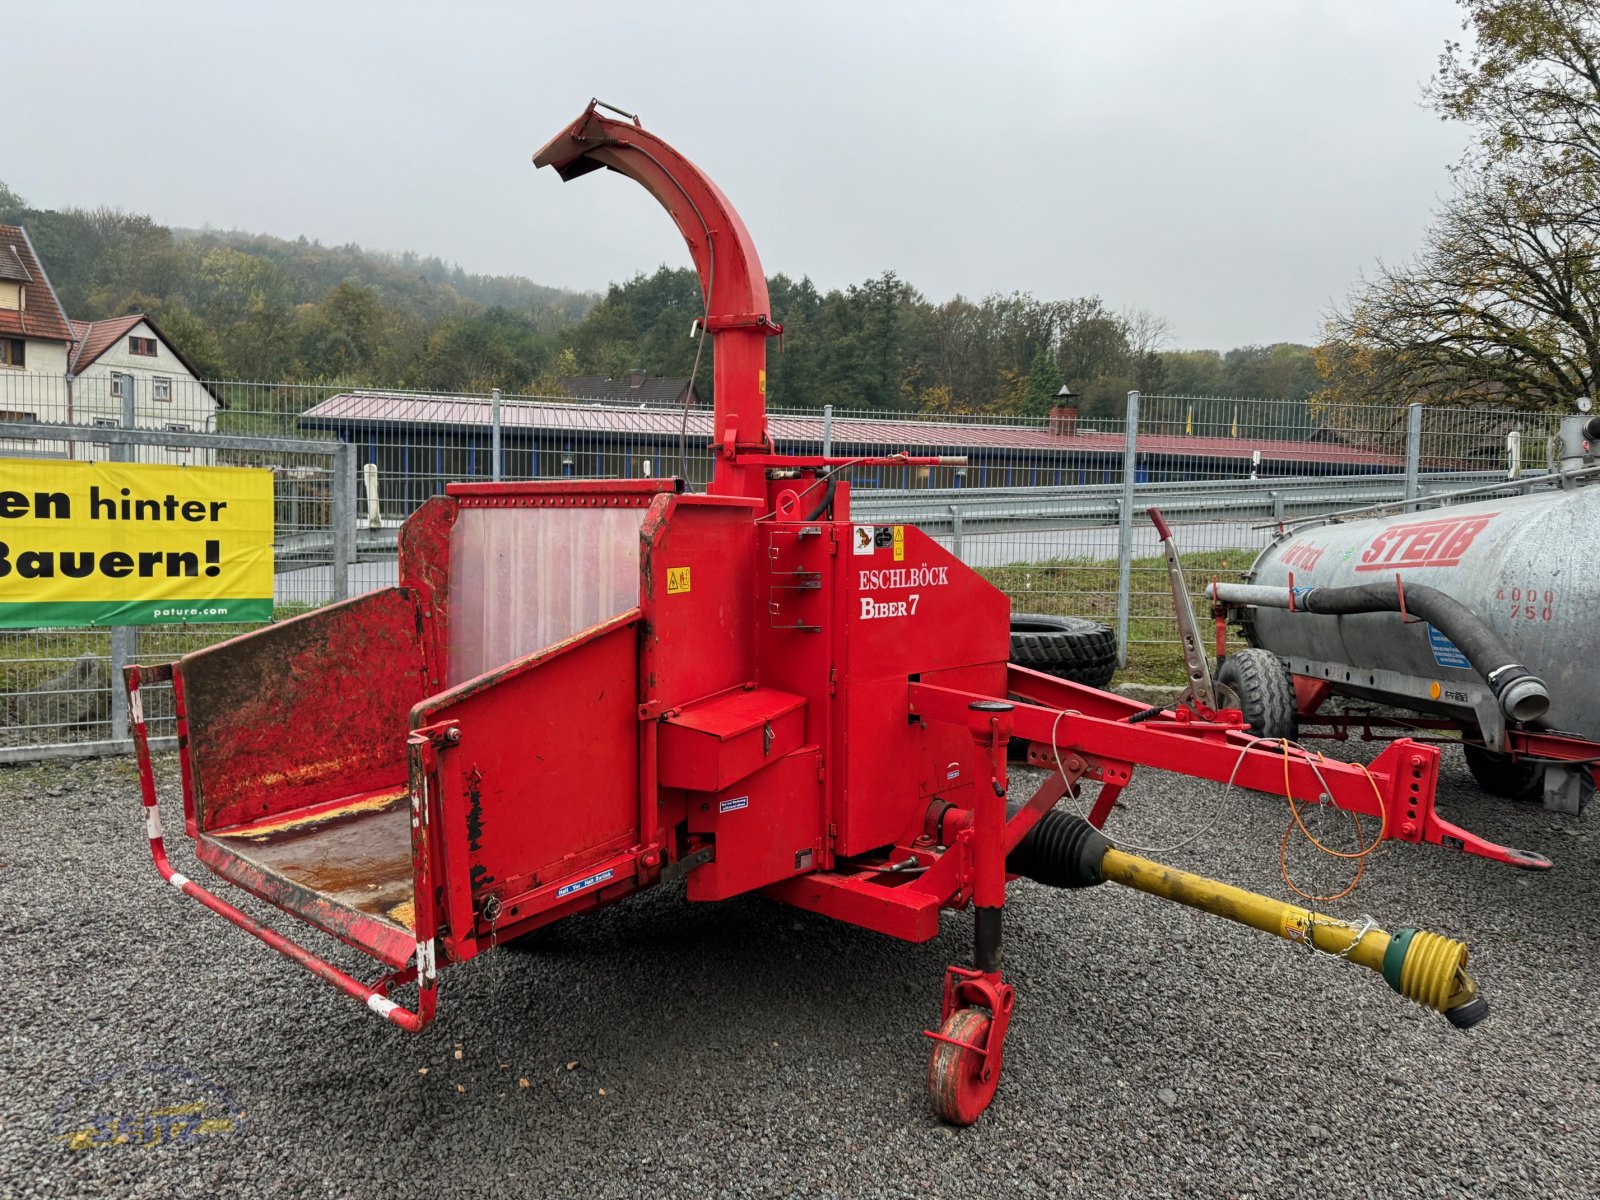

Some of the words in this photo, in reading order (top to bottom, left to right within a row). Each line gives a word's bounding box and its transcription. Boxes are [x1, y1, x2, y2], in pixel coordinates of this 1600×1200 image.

[90, 485, 227, 522] hinter
[1361, 517, 1490, 563] STEIB
[859, 563, 949, 591] ESCHLBÖCK
[153, 607, 228, 619] patura.com
[908, 594, 920, 616] 7
[1510, 604, 1553, 621] 750
